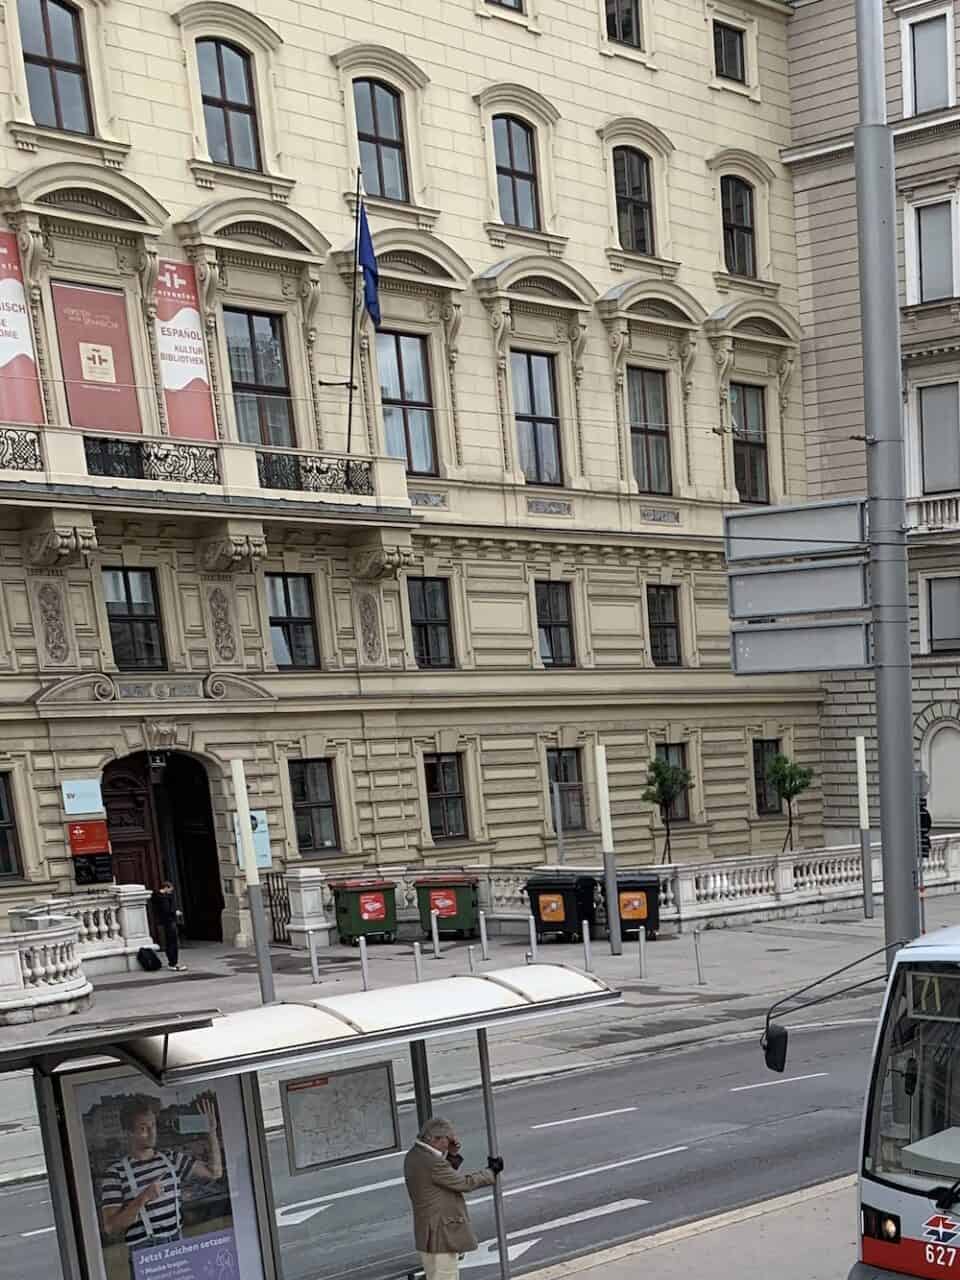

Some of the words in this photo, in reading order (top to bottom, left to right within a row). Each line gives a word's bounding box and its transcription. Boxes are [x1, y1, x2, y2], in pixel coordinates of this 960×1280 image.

[0, 302, 26, 313] ISCH
[160, 327, 202, 341] ESPAÑOL
[916, 976, 942, 1012] 71
[139, 1252, 163, 1265] Jetzt
[164, 1243, 200, 1259] Zeichen
[926, 1244, 957, 1268] 627
